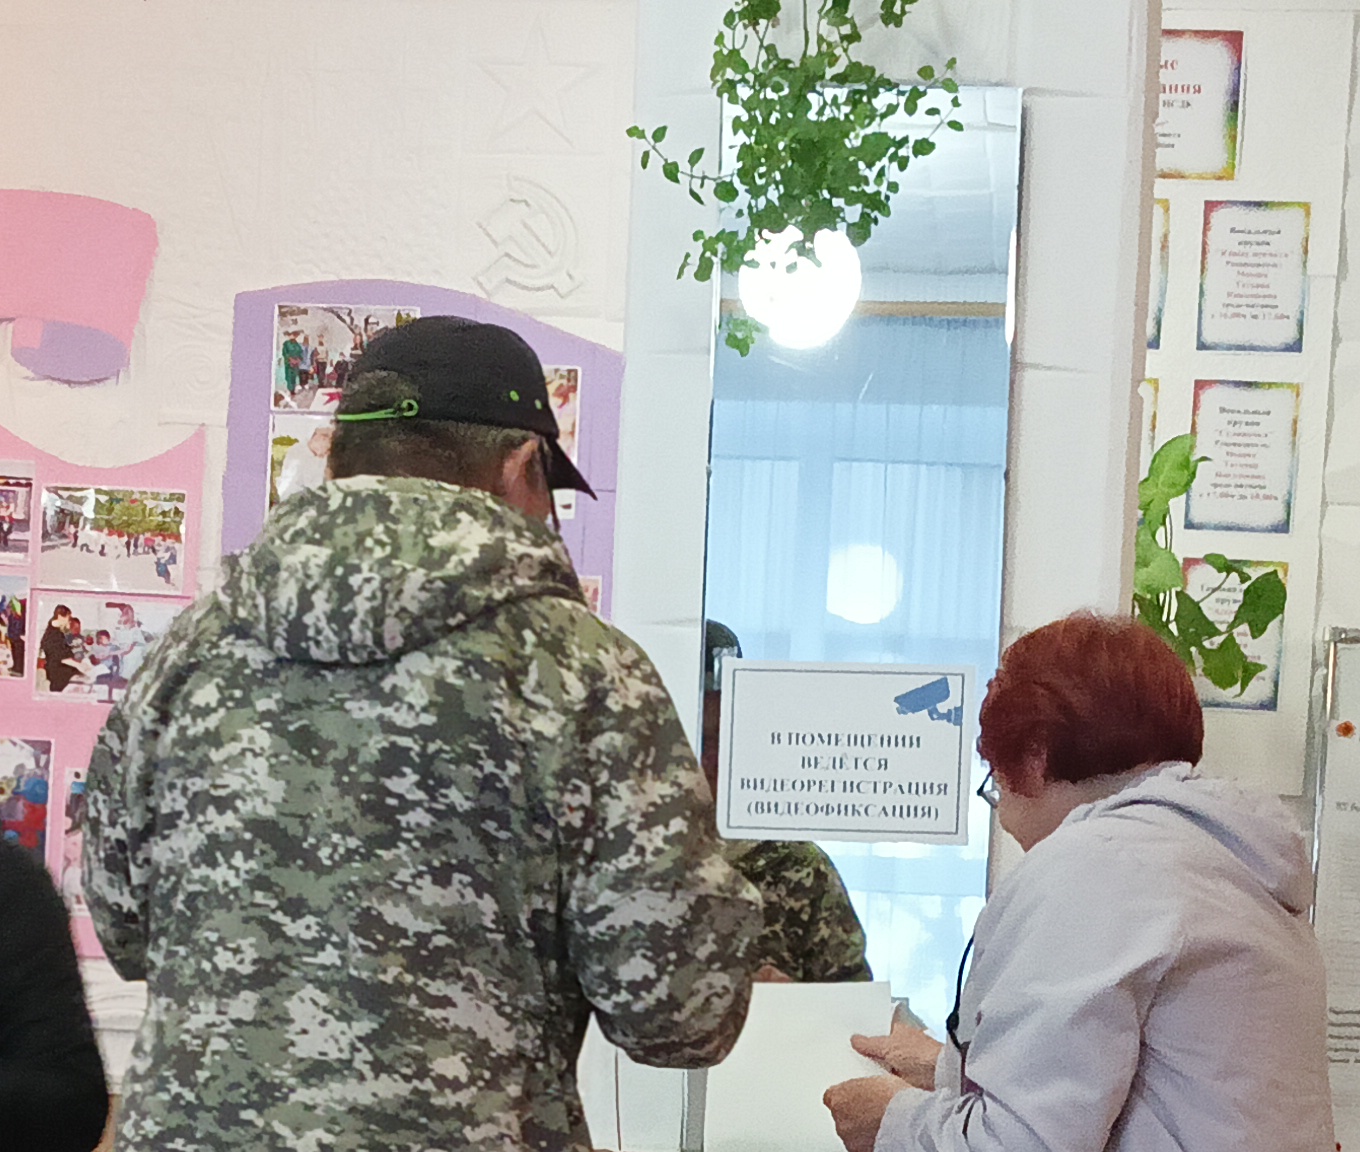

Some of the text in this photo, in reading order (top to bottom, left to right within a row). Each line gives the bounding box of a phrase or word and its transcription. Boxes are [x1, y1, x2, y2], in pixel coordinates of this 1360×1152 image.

[770, 731, 922, 749] В ПОМЕЩЕНИИ
[740, 777, 949, 796] ВИДЕОРЕГИСТРАЦИЯ
[746, 800, 939, 821] (ВИДЕОФИКСАЦИЯ)
